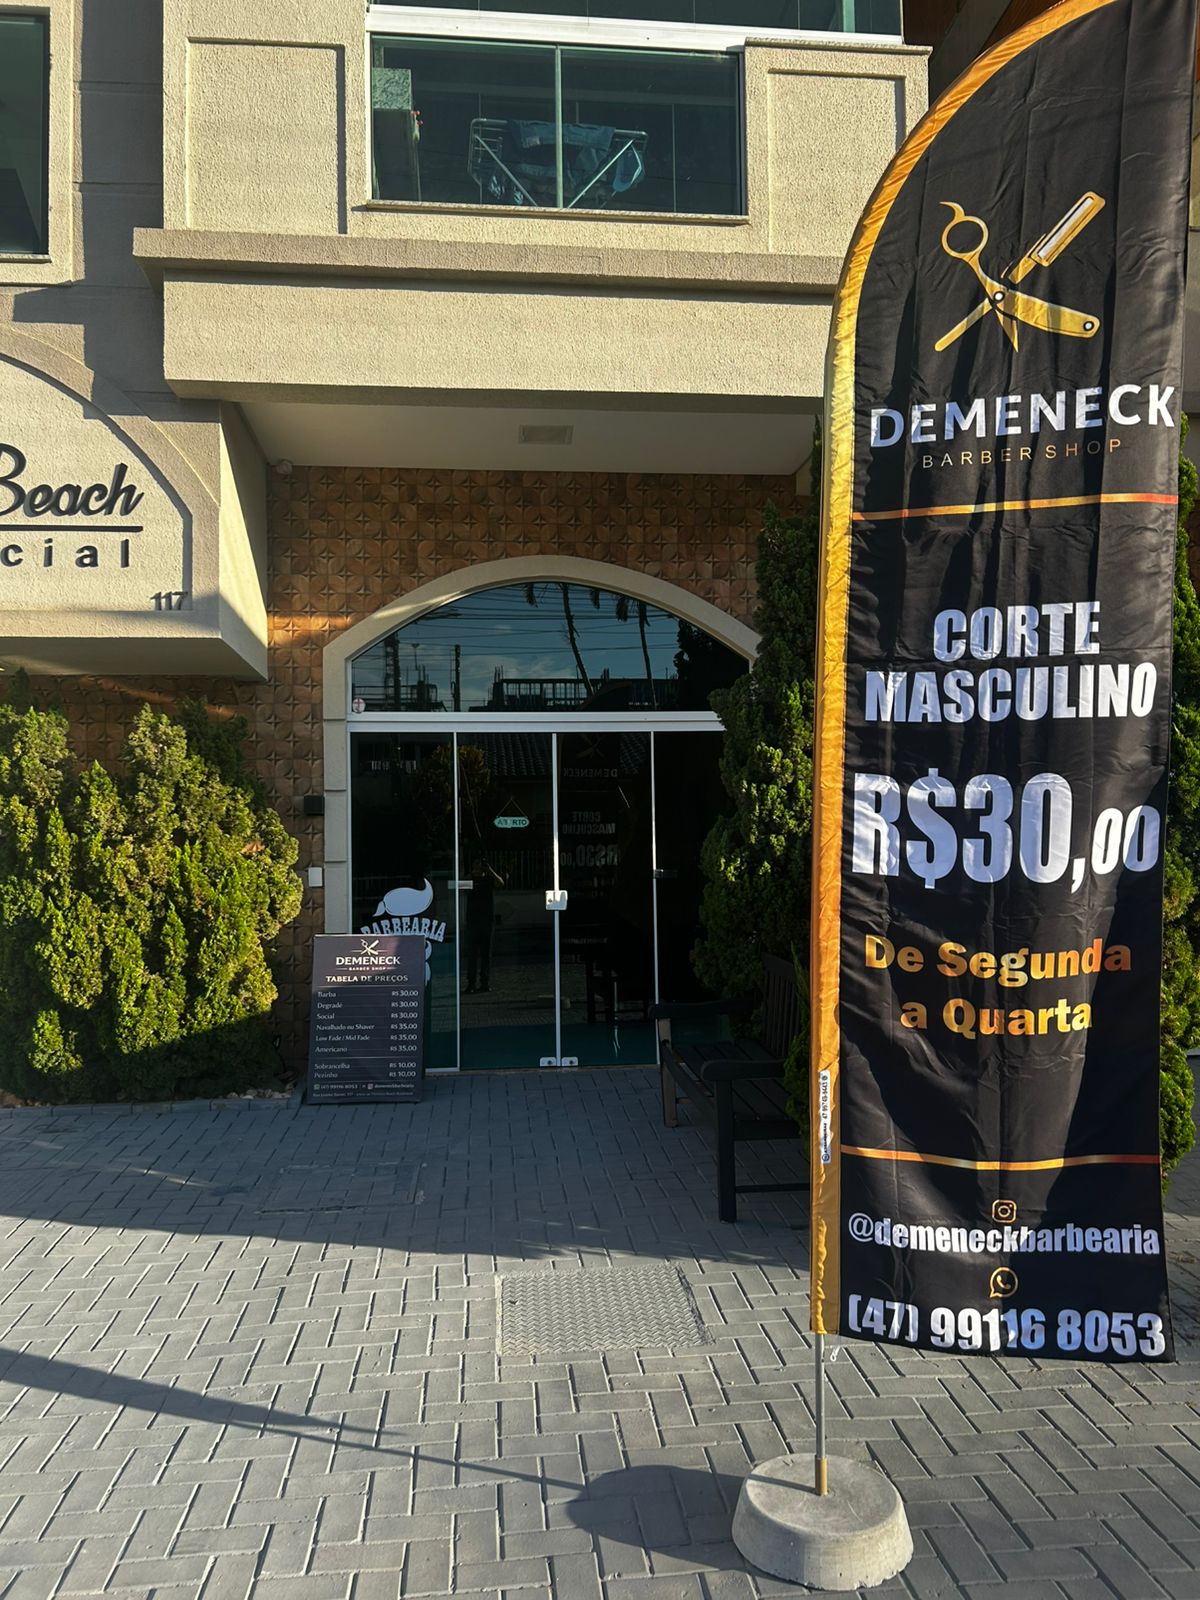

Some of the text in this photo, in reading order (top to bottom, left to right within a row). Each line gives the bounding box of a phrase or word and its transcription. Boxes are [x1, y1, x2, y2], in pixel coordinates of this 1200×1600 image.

[870, 384, 1175, 448] DEMENECK
[0, 442, 144, 518] Beach
[150, 591, 188, 611] 117
[932, 600, 1100, 662] CORTE
[865, 662, 1158, 723] MASCULINO
[851, 767, 1161, 894] R$30,00
[325, 975, 358, 983] TABELA
[374, 974, 409, 983] PREÇOS
[335, 956, 401, 965] DEMENECK
[865, 934, 1132, 988] De Segunda
[316, 1012, 335, 1020] Social
[900, 998, 1093, 1040] a Quarta
[848, 1212, 1160, 1255] @demeneckbarbearia
[848, 1294, 1166, 1356] (47) 99116 8053
